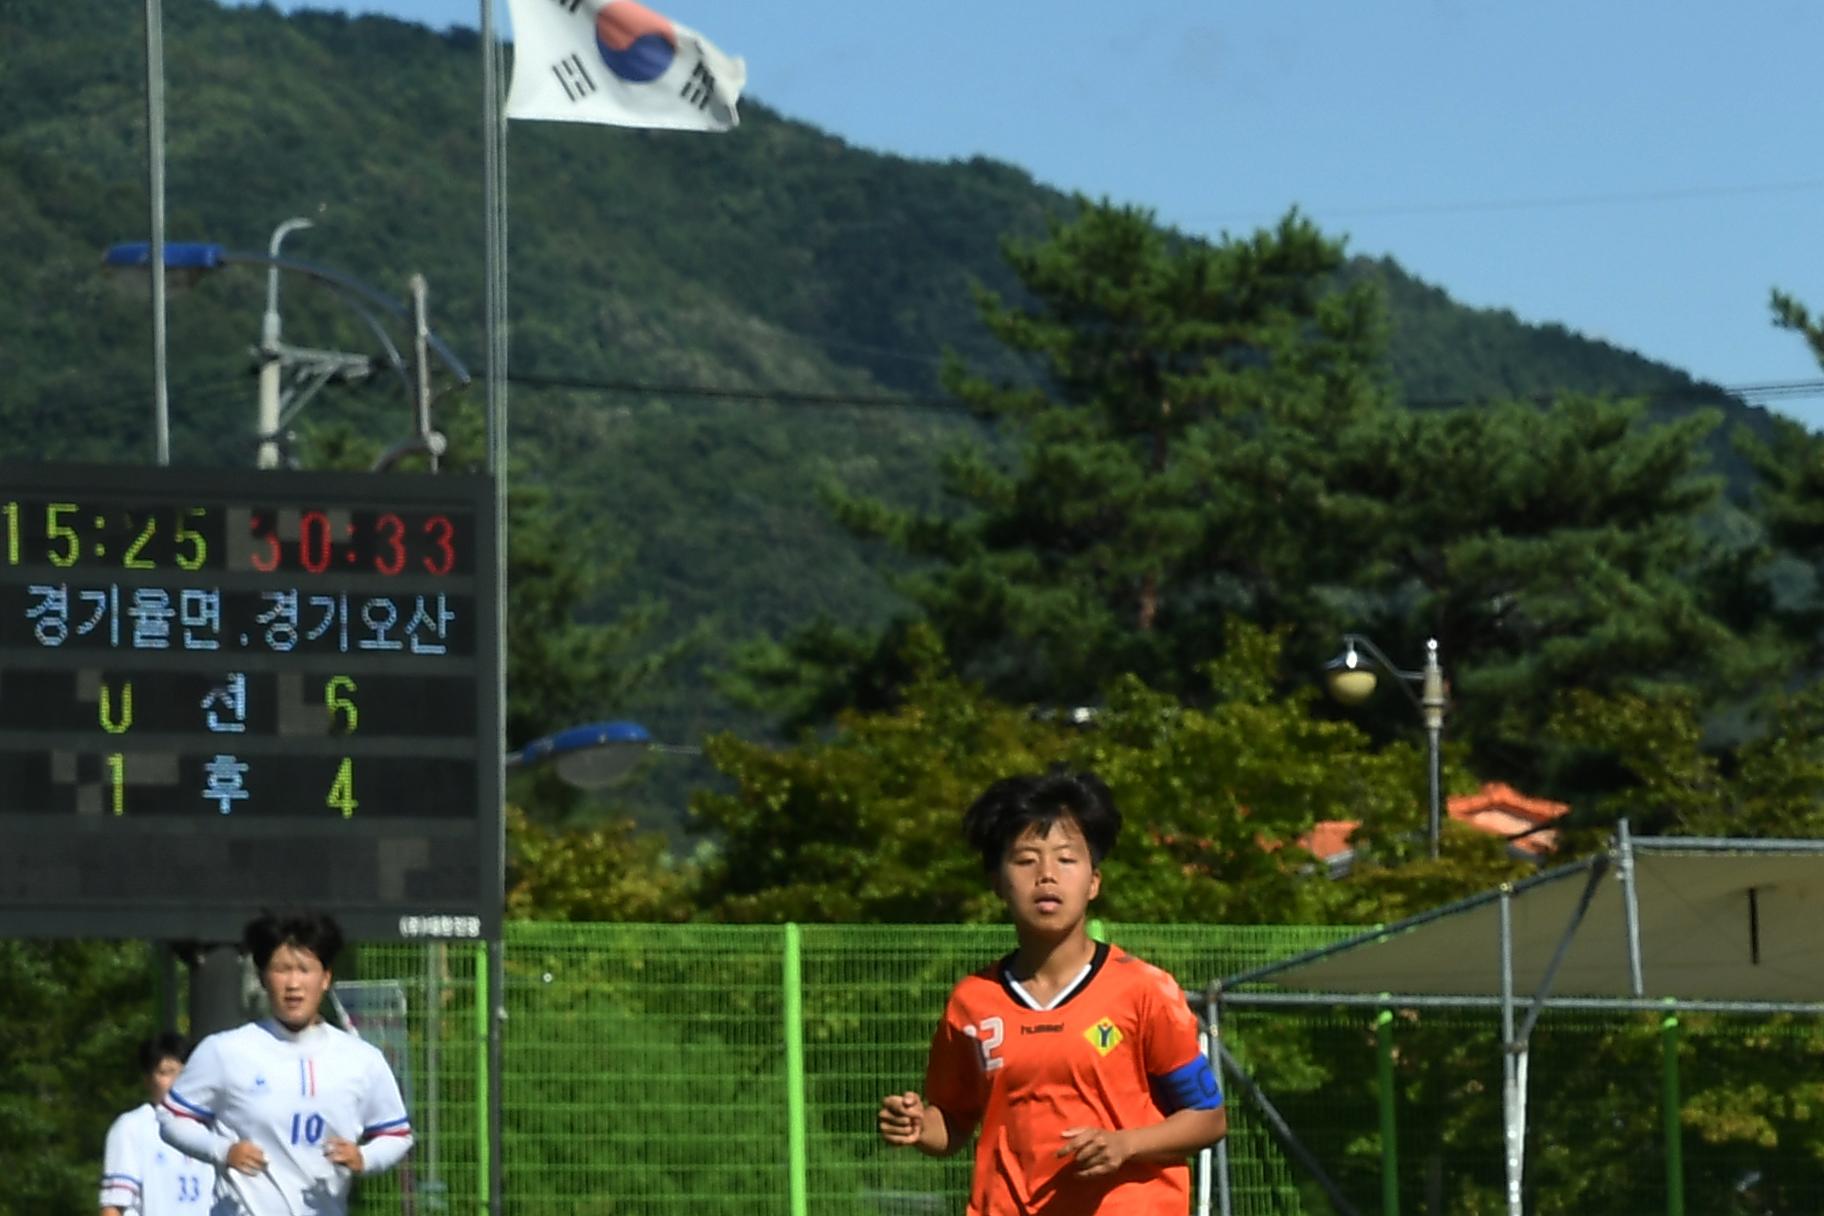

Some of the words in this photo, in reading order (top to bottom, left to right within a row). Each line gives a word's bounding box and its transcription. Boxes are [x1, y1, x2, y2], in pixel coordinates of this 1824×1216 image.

[256, 588, 456, 656] 경기오산
[106, 752, 125, 816] 1
[202, 754, 249, 815] 후
[326, 757, 359, 819] 4
[290, 1113, 323, 1144] 10
[177, 1176, 199, 1202] 33
